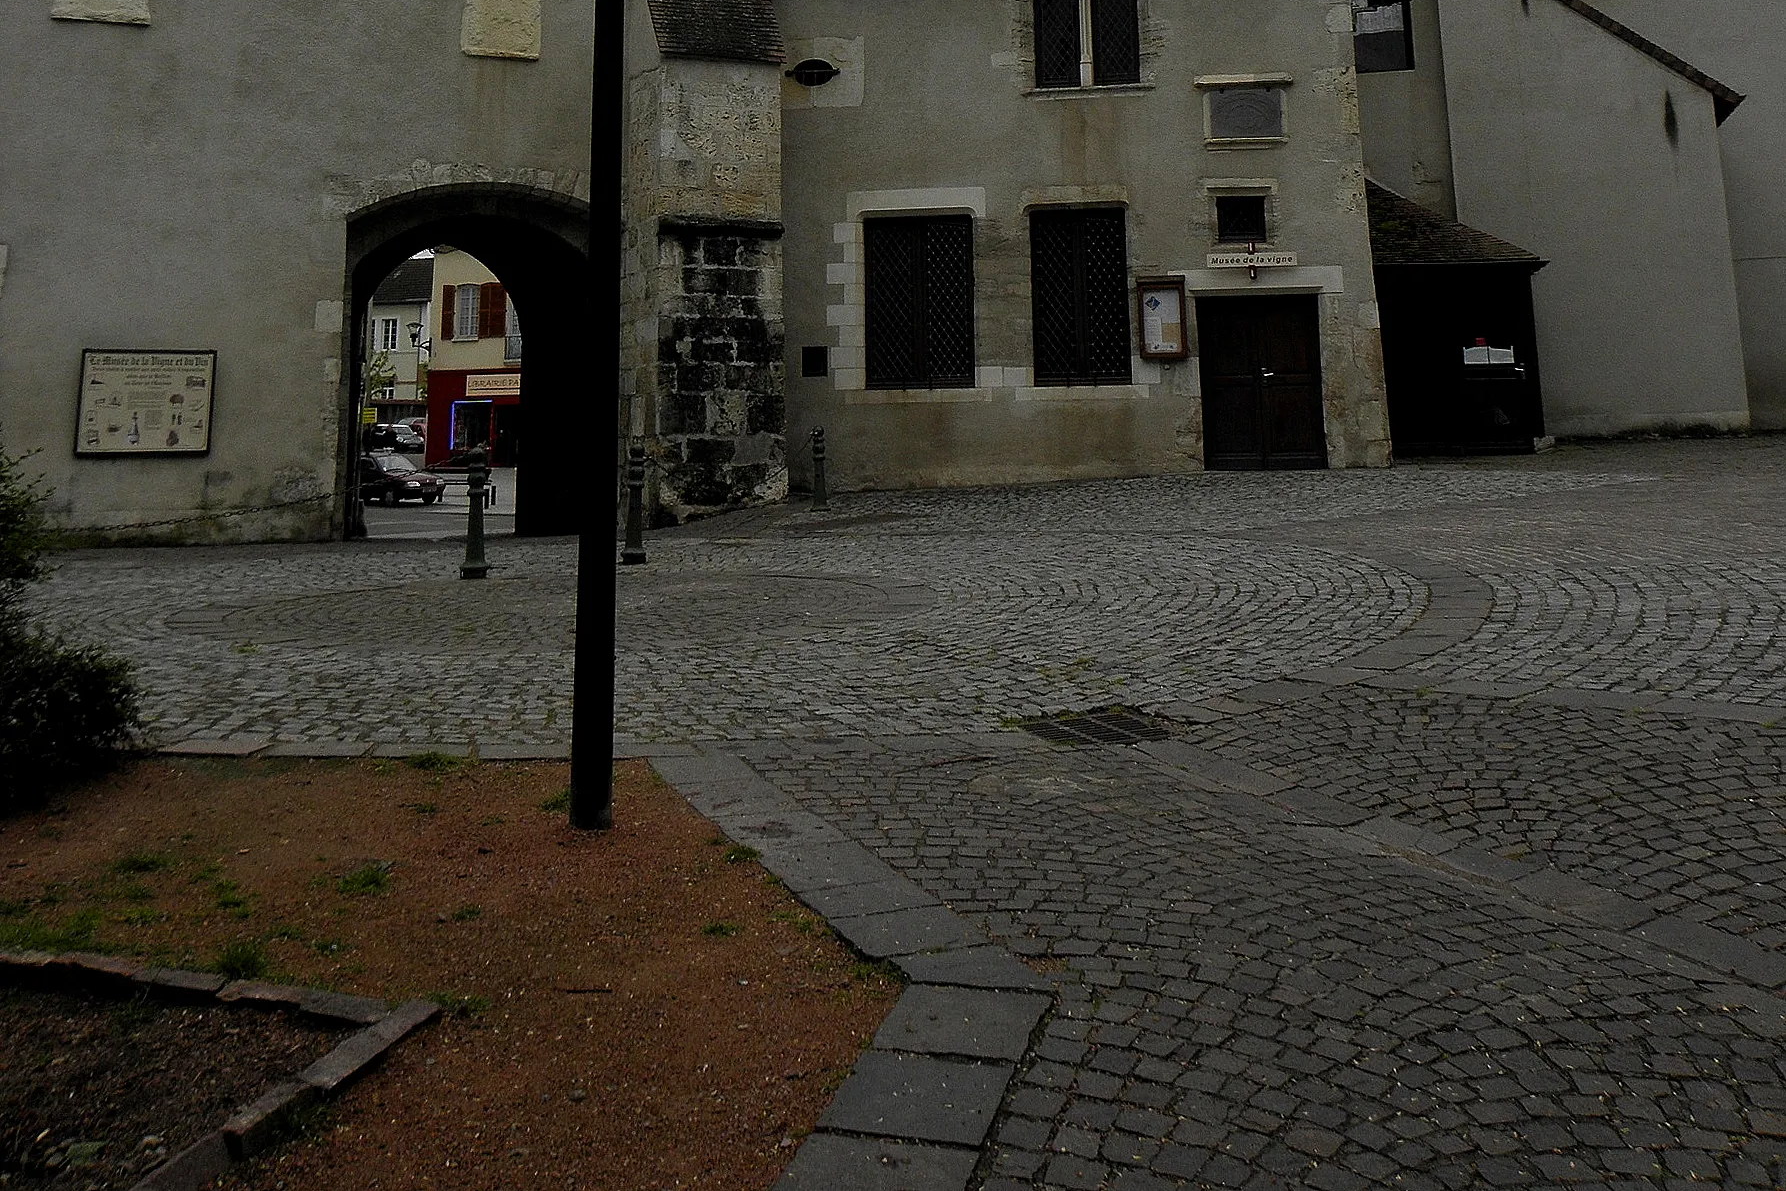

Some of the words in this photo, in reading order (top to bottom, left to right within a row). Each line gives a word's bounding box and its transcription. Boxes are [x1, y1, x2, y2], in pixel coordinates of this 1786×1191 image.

[1211, 257, 1241, 265] Musée
[1243, 256, 1254, 264] de
[1267, 256, 1293, 264] vigne
[88, 355, 100, 366] Le
[131, 356, 140, 366] de
[141, 356, 150, 366] la
[151, 356, 173, 368] Vigne
[175, 357, 183, 366] et
[184, 356, 195, 367] du
[195, 356, 209, 368] Vin
[468, 379, 506, 388] LIBRAIRIE
